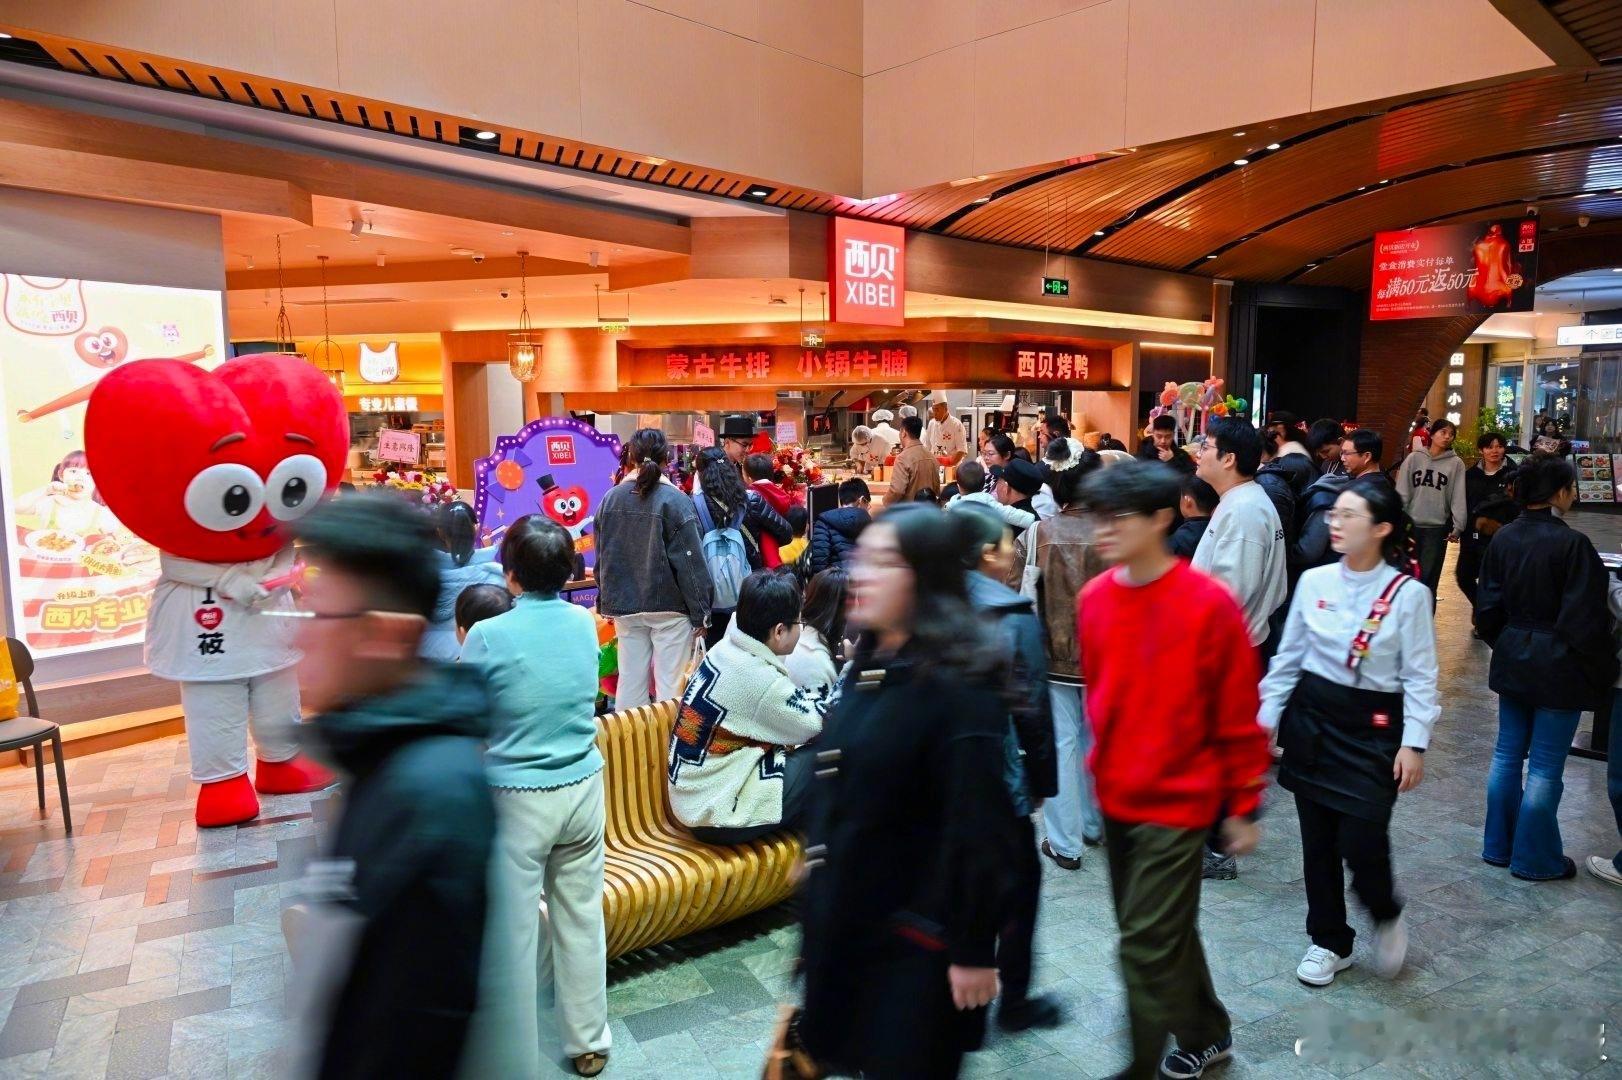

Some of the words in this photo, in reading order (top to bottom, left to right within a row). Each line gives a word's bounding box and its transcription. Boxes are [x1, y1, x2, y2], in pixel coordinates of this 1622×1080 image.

[845, 239, 896, 281] 西贝
[845, 280, 895, 308] XIBEI
[666, 353, 770, 380] 蒙古牛排
[797, 349, 909, 379] 小锅牛腩
[1017, 351, 1089, 380] 西贝烤鸭
[551, 441, 571, 452] 西贝
[552, 452, 571, 460] XIBEI
[1412, 470, 1449, 491] GAP
[202, 587, 215, 604] I
